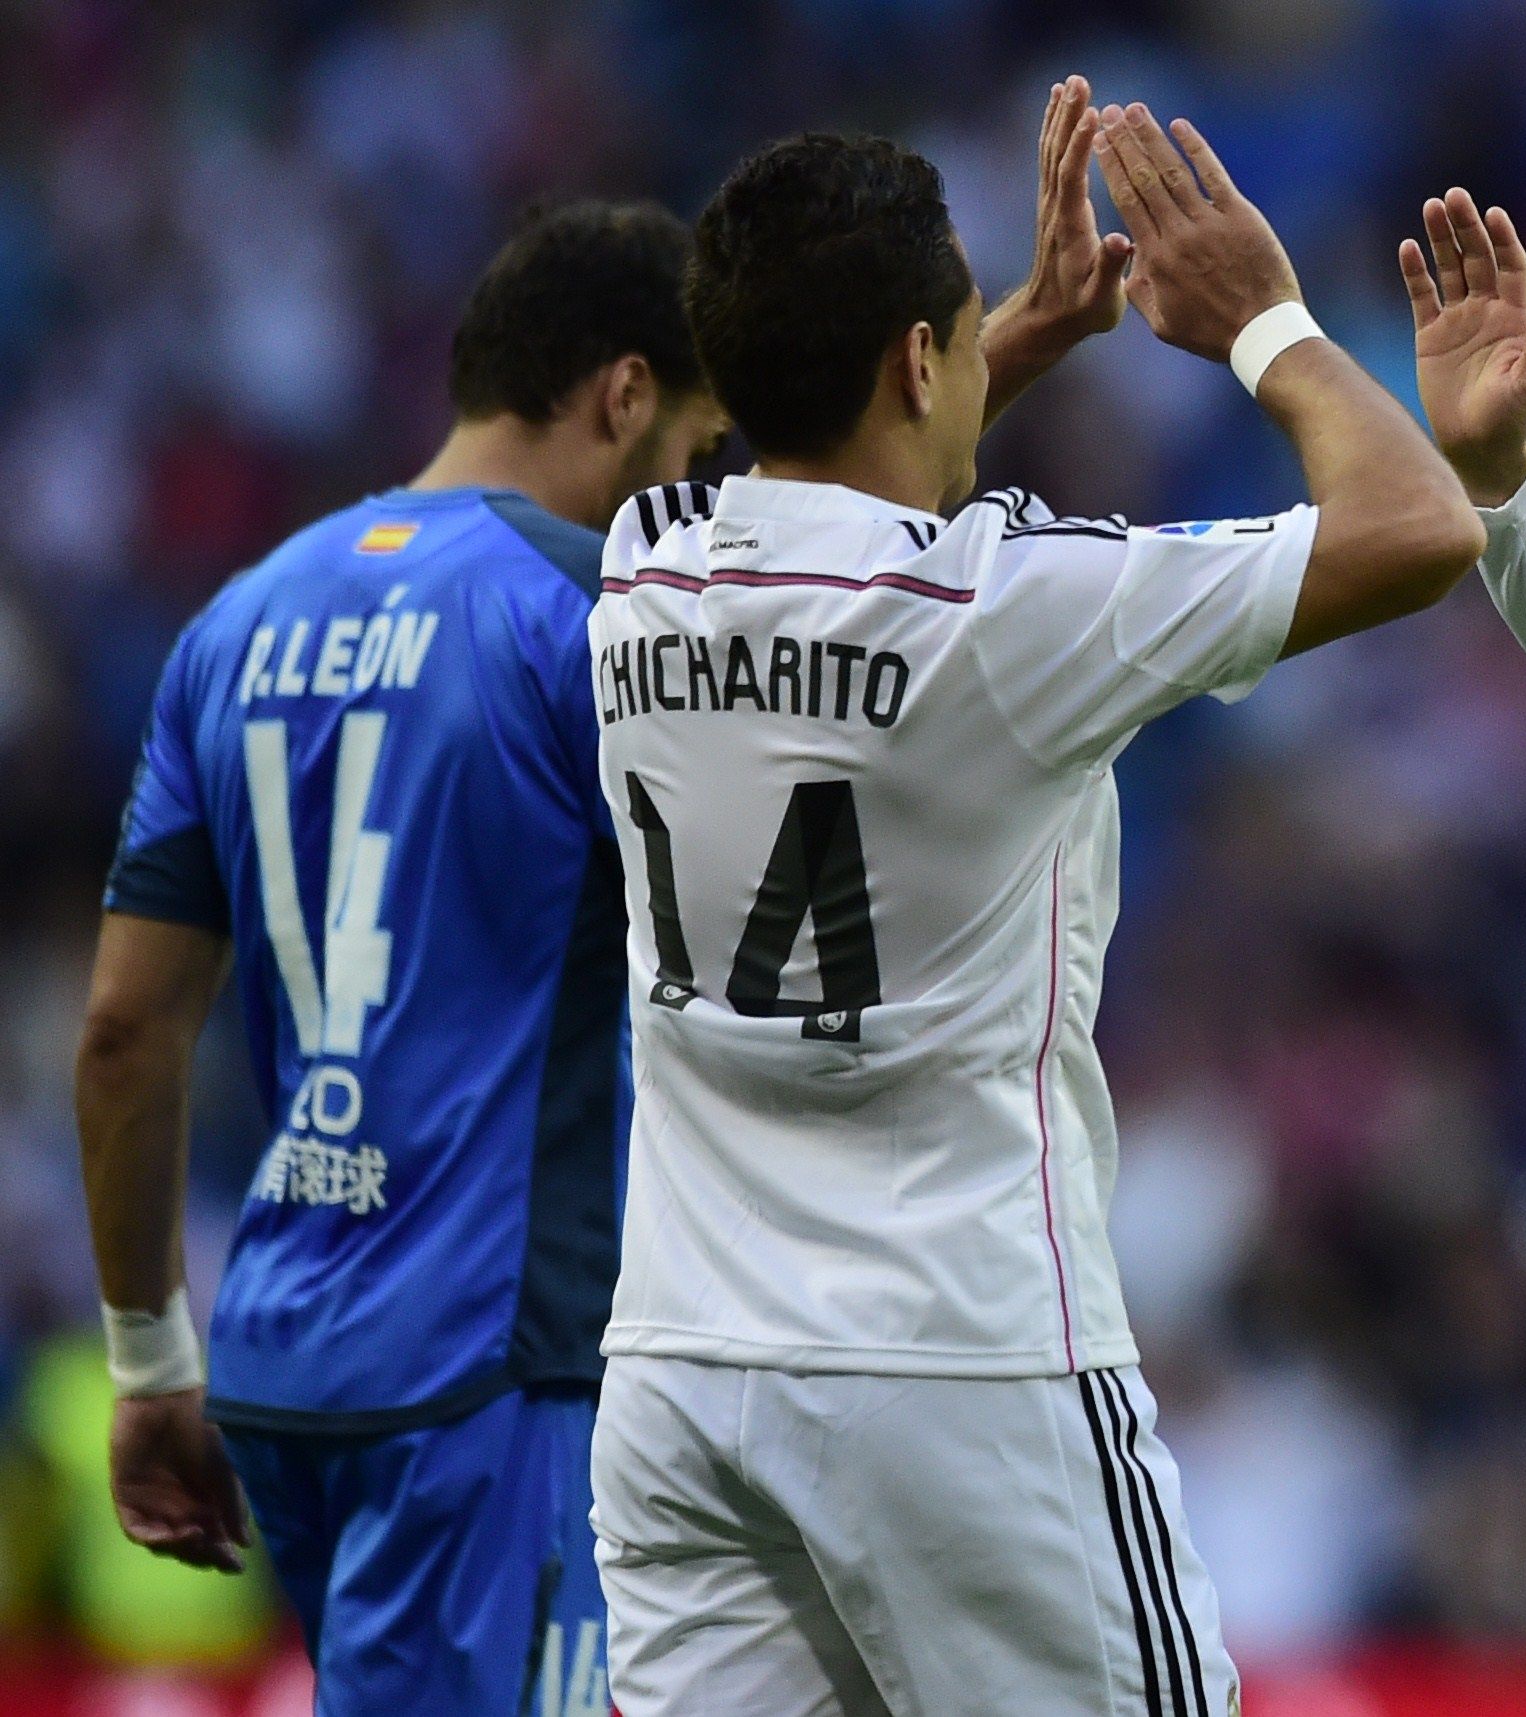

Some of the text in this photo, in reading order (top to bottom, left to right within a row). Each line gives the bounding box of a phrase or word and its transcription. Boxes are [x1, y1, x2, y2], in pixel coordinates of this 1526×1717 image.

[239, 583, 439, 705] P.LEÓN
[600, 633, 909, 728] CHICHARITO
[243, 711, 393, 1058] 14
[624, 770, 882, 1043] 14
